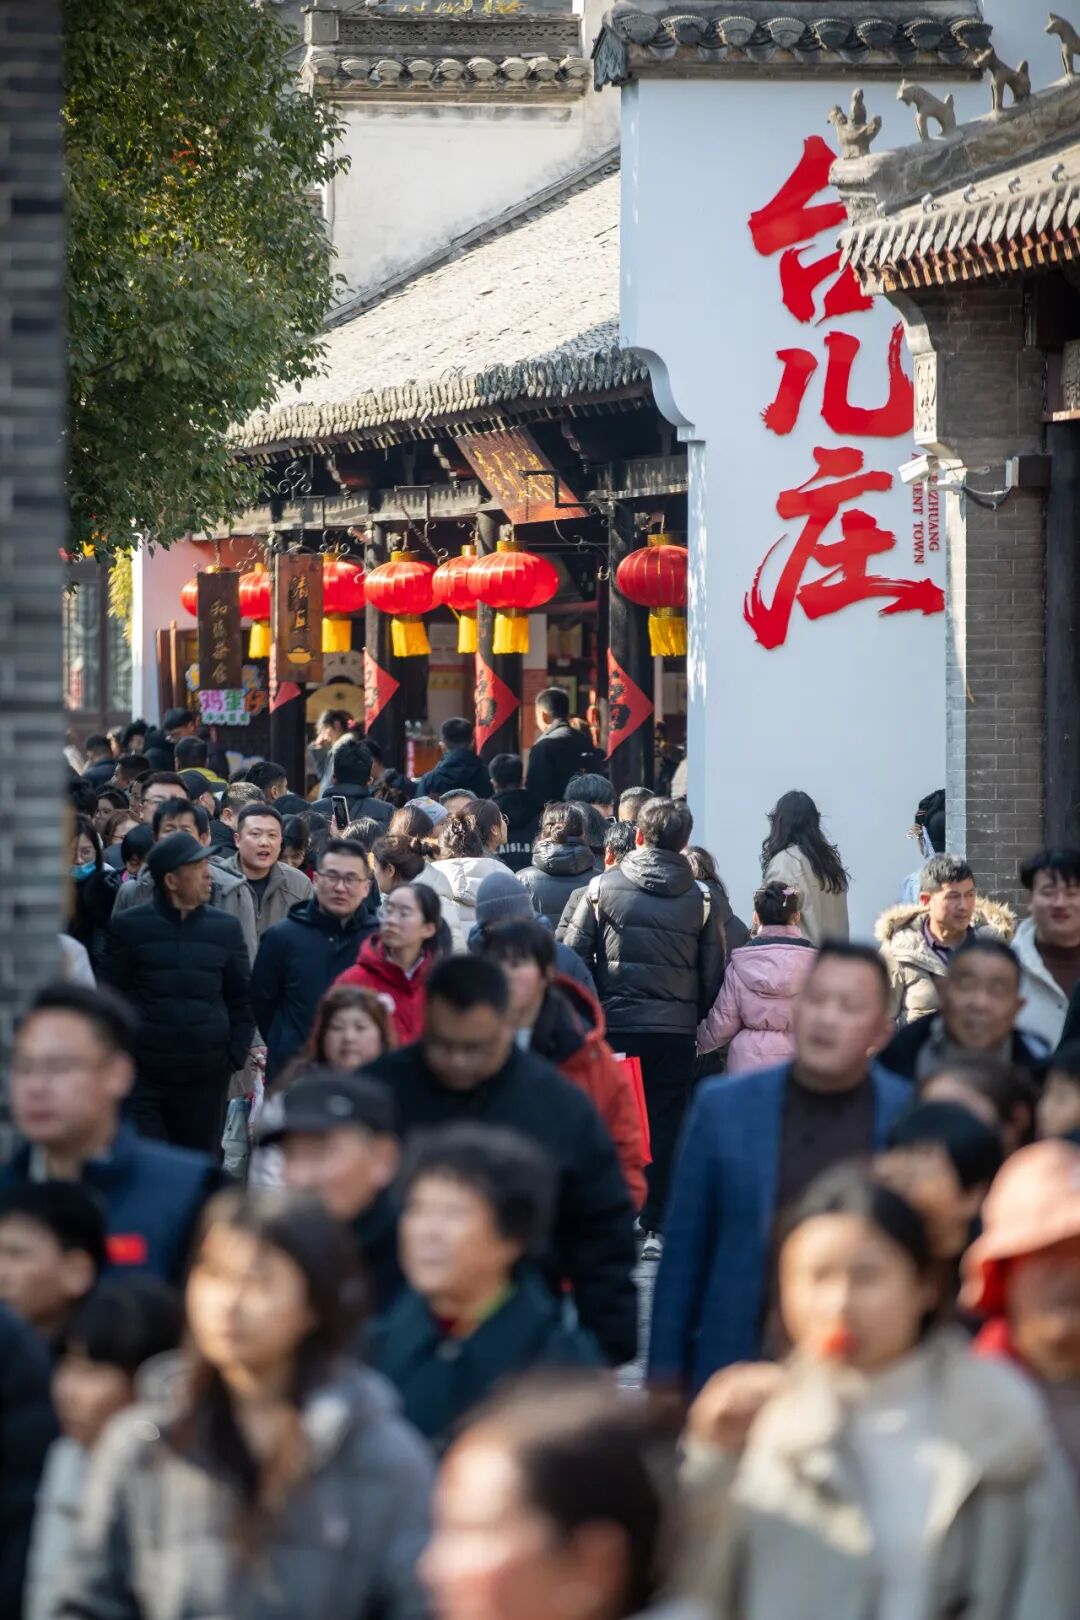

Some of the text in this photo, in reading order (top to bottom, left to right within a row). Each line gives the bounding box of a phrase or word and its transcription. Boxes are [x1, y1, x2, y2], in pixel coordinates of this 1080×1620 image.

[744, 135, 945, 650] 台儿庄
[913, 521, 924, 564] TOWN
